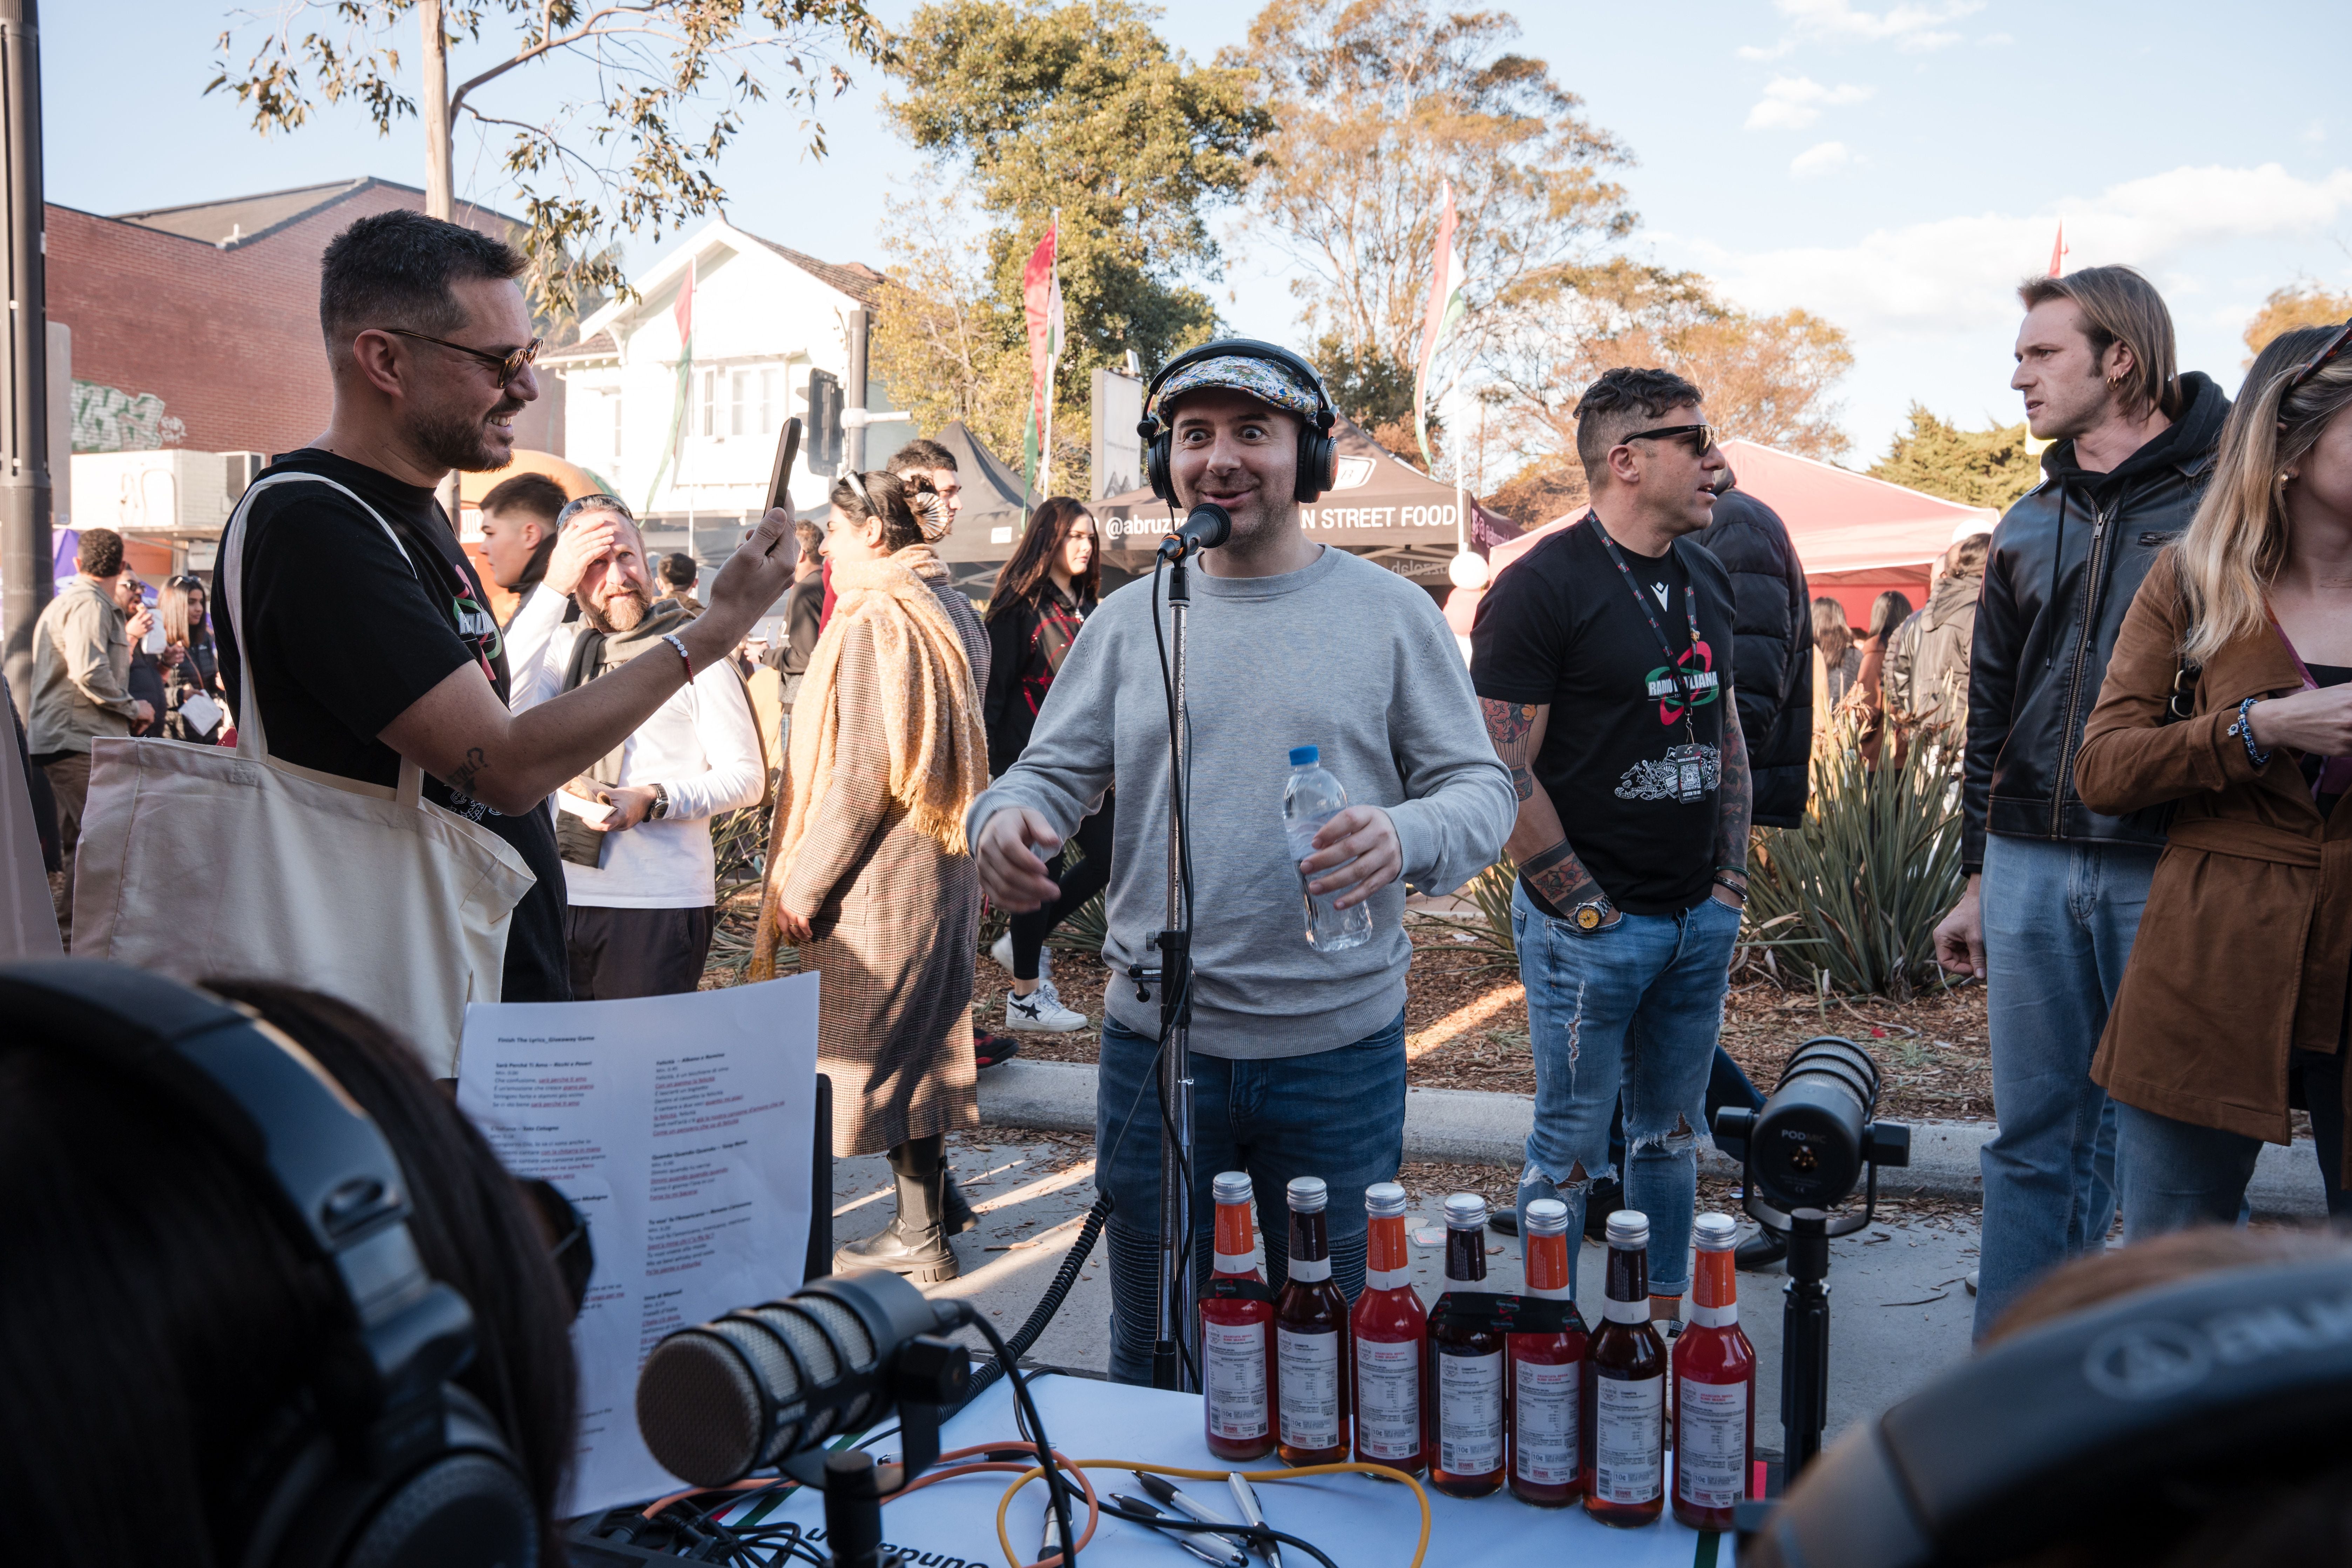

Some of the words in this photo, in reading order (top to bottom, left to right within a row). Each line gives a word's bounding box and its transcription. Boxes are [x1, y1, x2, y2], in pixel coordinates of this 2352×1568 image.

[1321, 507, 1396, 529] STREET
[1401, 505, 1457, 527] FOOD
[1648, 678, 1674, 696] RADIO
[1673, 671, 1718, 693] ILIANA
[1782, 1129, 1826, 1144] PODMIC
